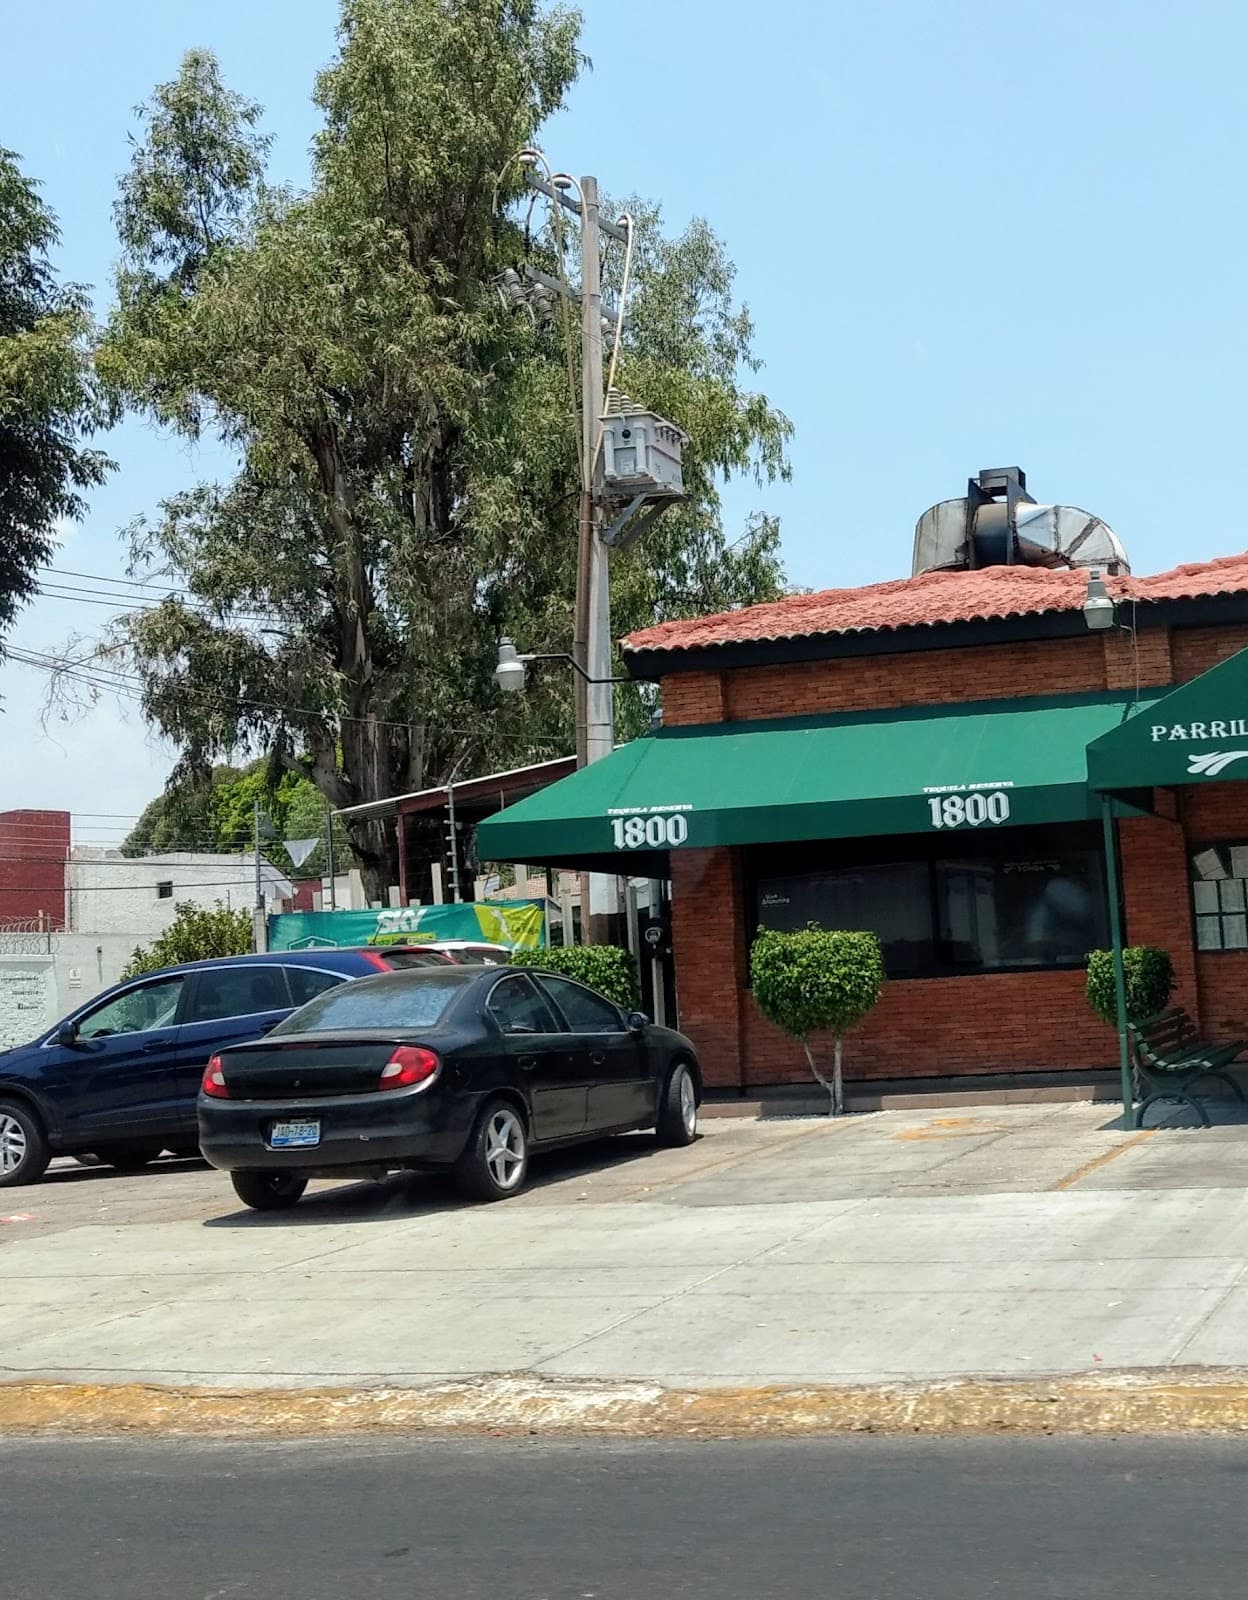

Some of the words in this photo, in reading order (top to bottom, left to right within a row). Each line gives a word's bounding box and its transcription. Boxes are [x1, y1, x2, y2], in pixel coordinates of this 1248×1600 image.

[923, 785, 966, 793] TEQUILA
[927, 791, 1010, 829] 1800
[611, 814, 688, 849] 1800
[375, 908, 429, 934] SKY
